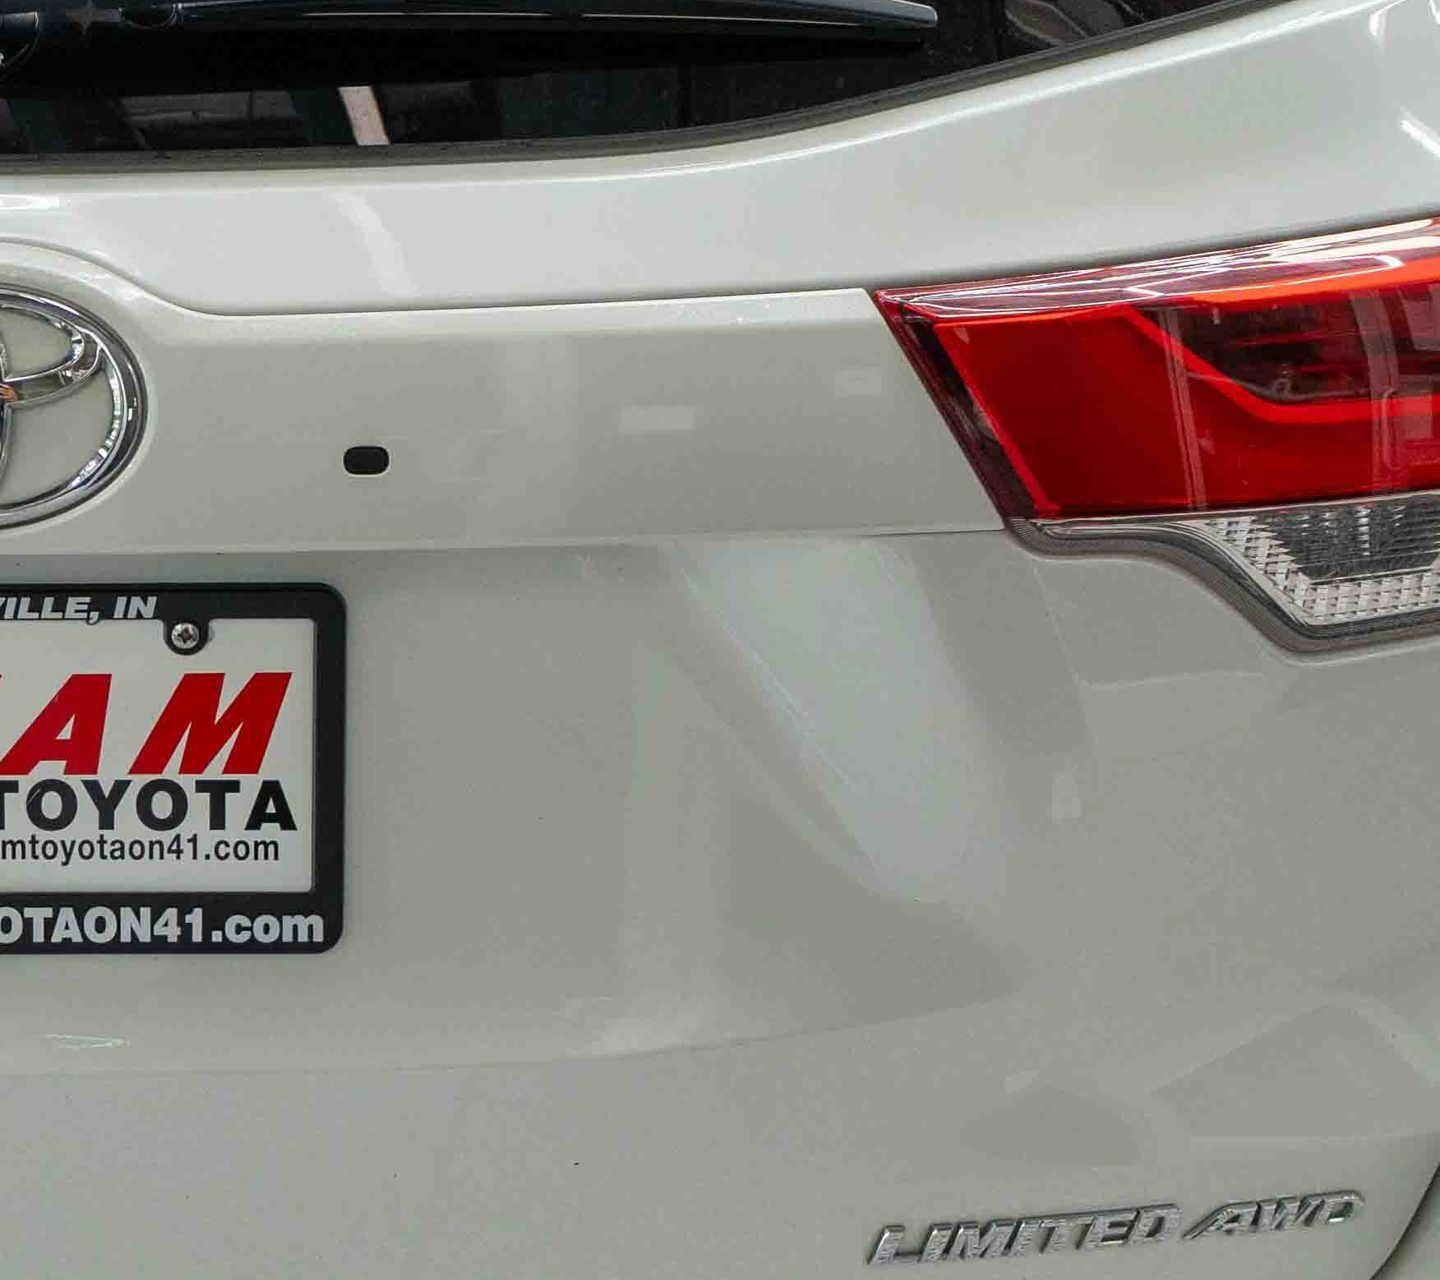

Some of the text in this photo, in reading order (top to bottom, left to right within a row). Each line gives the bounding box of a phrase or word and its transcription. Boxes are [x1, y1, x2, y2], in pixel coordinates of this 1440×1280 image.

[111, 595, 157, 619] IN
[867, 1189, 1366, 1265] LIMITED AWD
